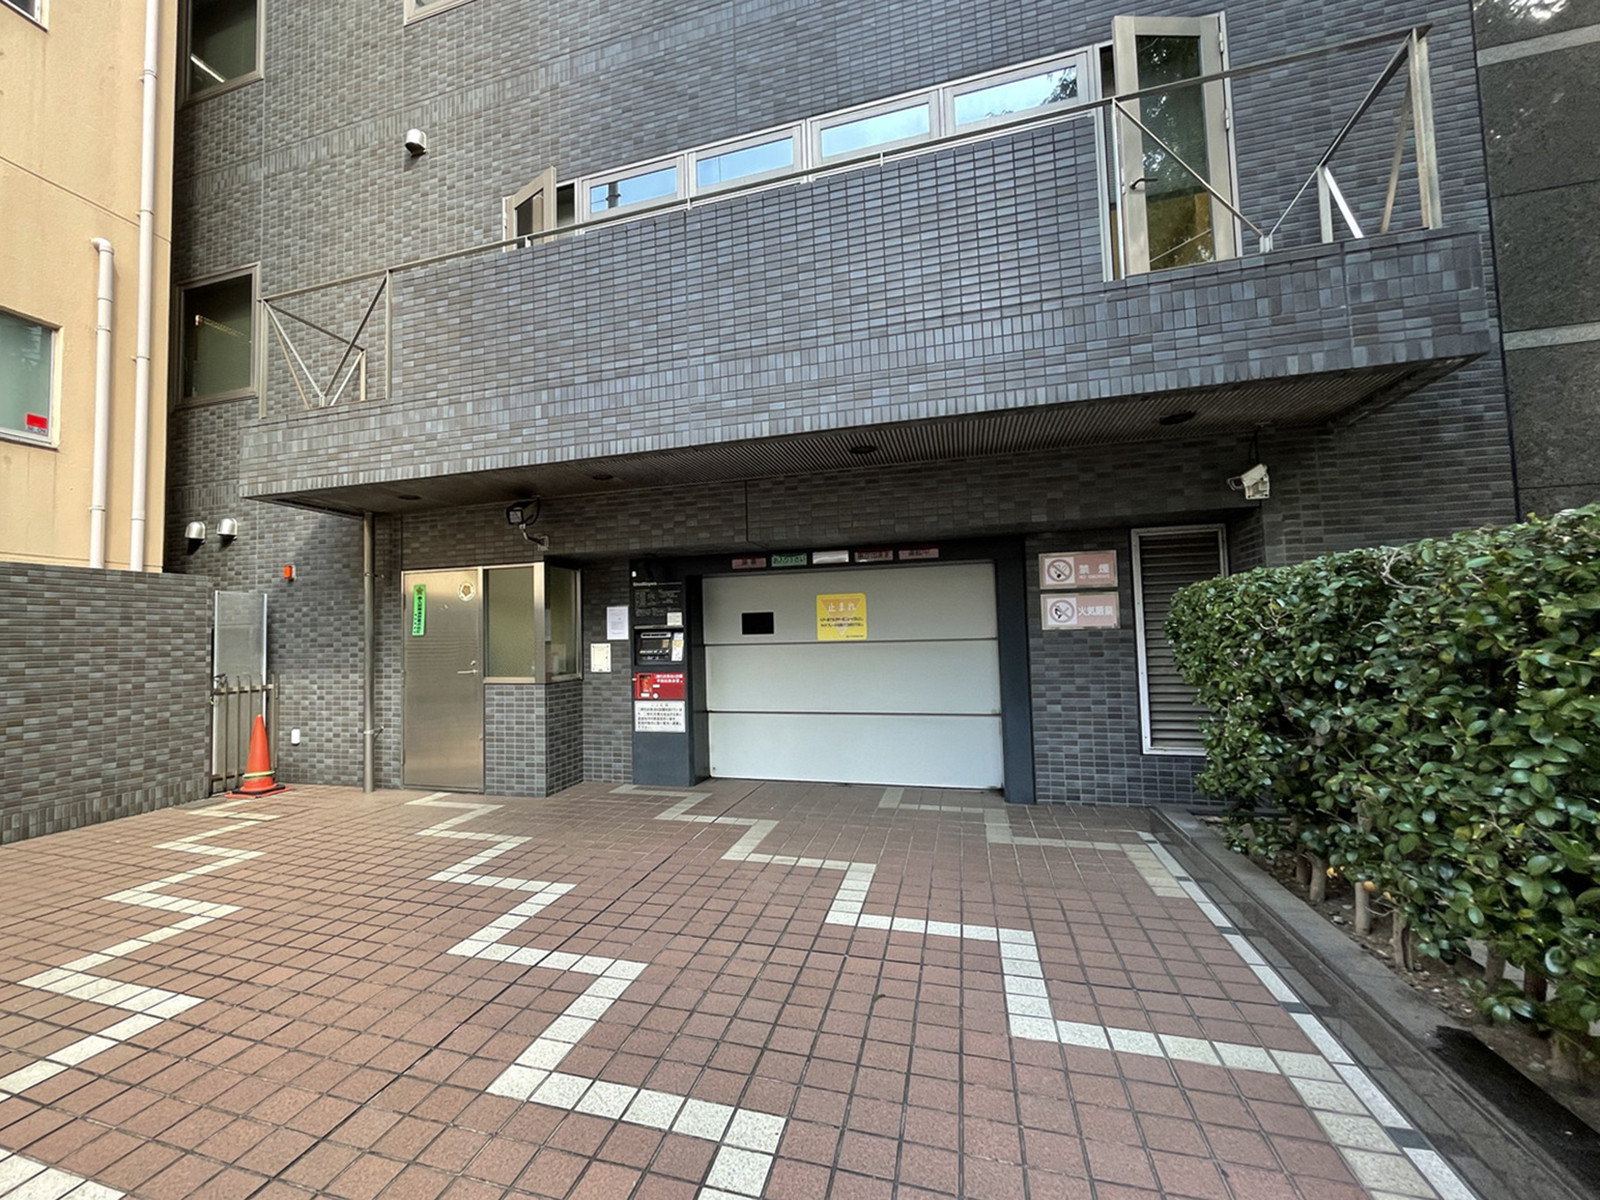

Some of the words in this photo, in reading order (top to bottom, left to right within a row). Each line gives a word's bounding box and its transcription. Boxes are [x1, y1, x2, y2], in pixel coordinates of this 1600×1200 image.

[828, 601, 857, 612] 止まれ
[1078, 606, 1113, 616] 火気厳禁
